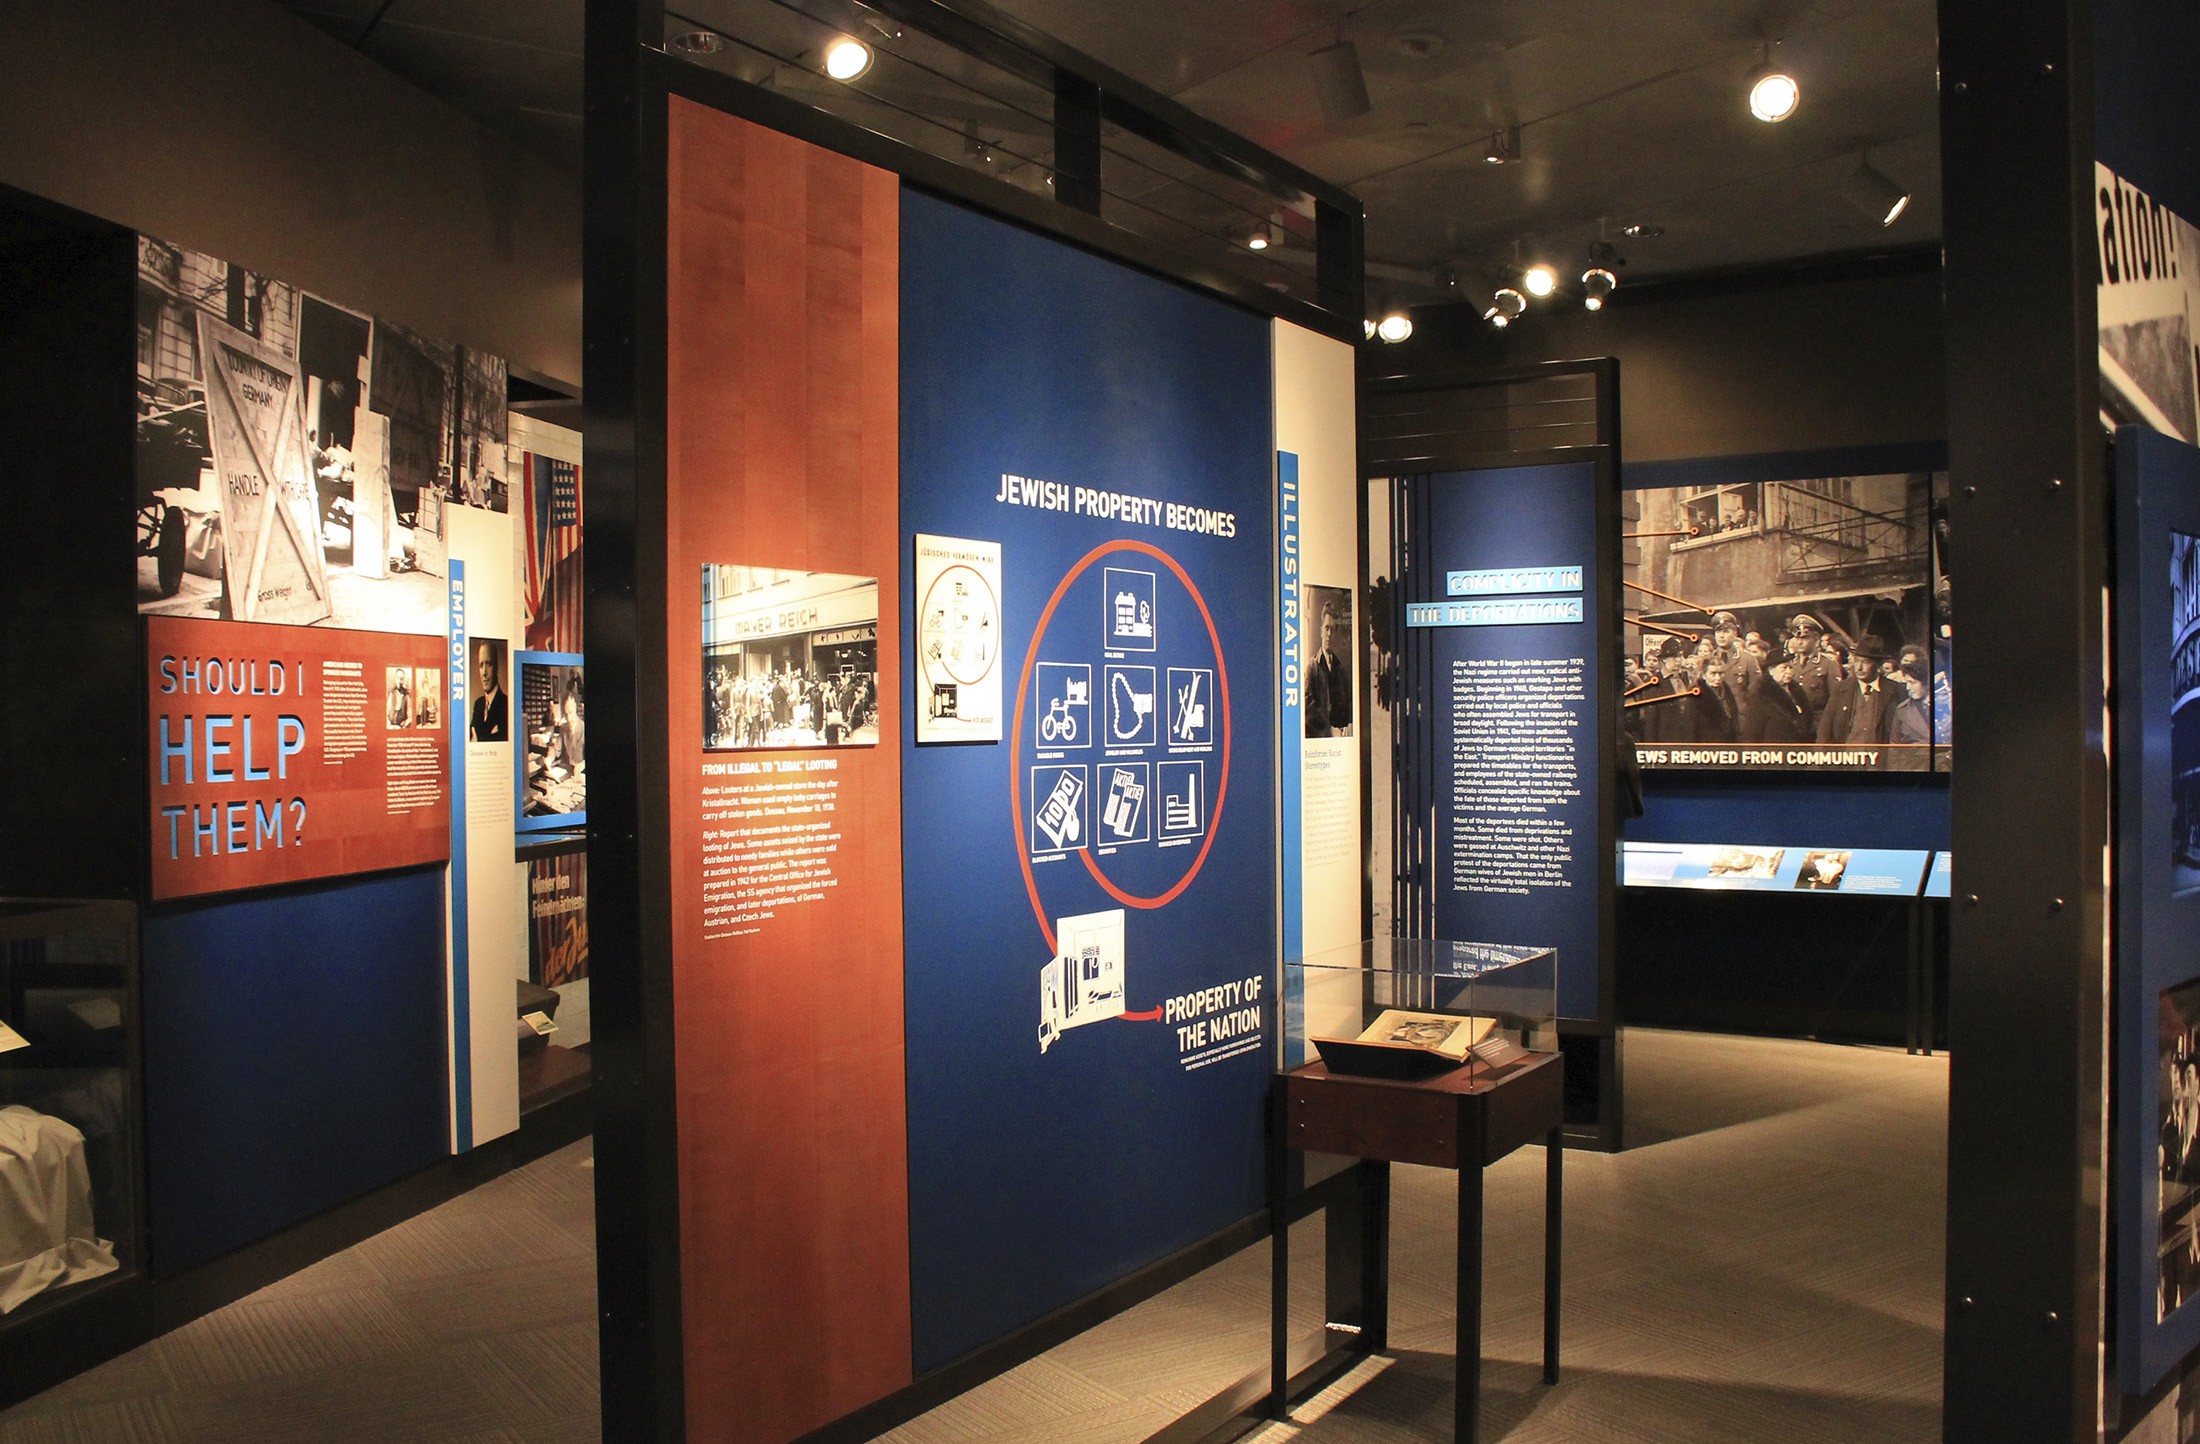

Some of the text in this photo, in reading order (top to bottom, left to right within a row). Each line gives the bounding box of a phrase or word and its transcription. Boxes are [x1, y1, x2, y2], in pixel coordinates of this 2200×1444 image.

[227, 472, 260, 496] HANDLE
[996, 473, 1236, 538] JEWISH PROPERTY BECOMES
[1450, 571, 1580, 592] COMPLICITY IN
[1283, 482, 1298, 708] ILLUSTRATOR
[779, 606, 818, 628] REICH
[1410, 602, 1580, 623] THE DEPORTATIONS
[452, 580, 464, 700] EMPLOYER
[1477, 668, 1498, 676] regime
[1504, 659, 1524, 668] began
[160, 655, 286, 696] SHOULD
[298, 660, 304, 696] I
[1526, 676, 1551, 684] marking
[1477, 685, 1506, 694] Beginning
[1528, 685, 1553, 693] Gestapo
[160, 714, 306, 786] HELP
[1636, 750, 1879, 766] EWS REMOVED FROM COMMUNITY
[702, 764, 726, 775] FROM
[727, 763, 761, 774] ILLEGAL
[805, 759, 837, 770] LOOTING
[1126, 786, 1141, 800] AKTIE
[161, 796, 306, 860] THEM?
[1486, 817, 1515, 826] deportees
[1524, 827, 1559, 836] deprivations
[1469, 842, 1489, 851] gassed
[737, 890, 746, 898] the
[756, 888, 775, 897] agency
[775, 885, 786, 893] that
[786, 881, 812, 894] organized
[812, 880, 821, 888] the
[821, 878, 837, 887] forced
[737, 901, 747, 910] and
[748, 900, 760, 908] later
[731, 915, 741, 923] and
[742, 912, 759, 922] Czech
[1165, 974, 1262, 1025] PROPERTY OF
[1176, 1022, 1206, 1053] THE
[1210, 1005, 1261, 1044] NATION
